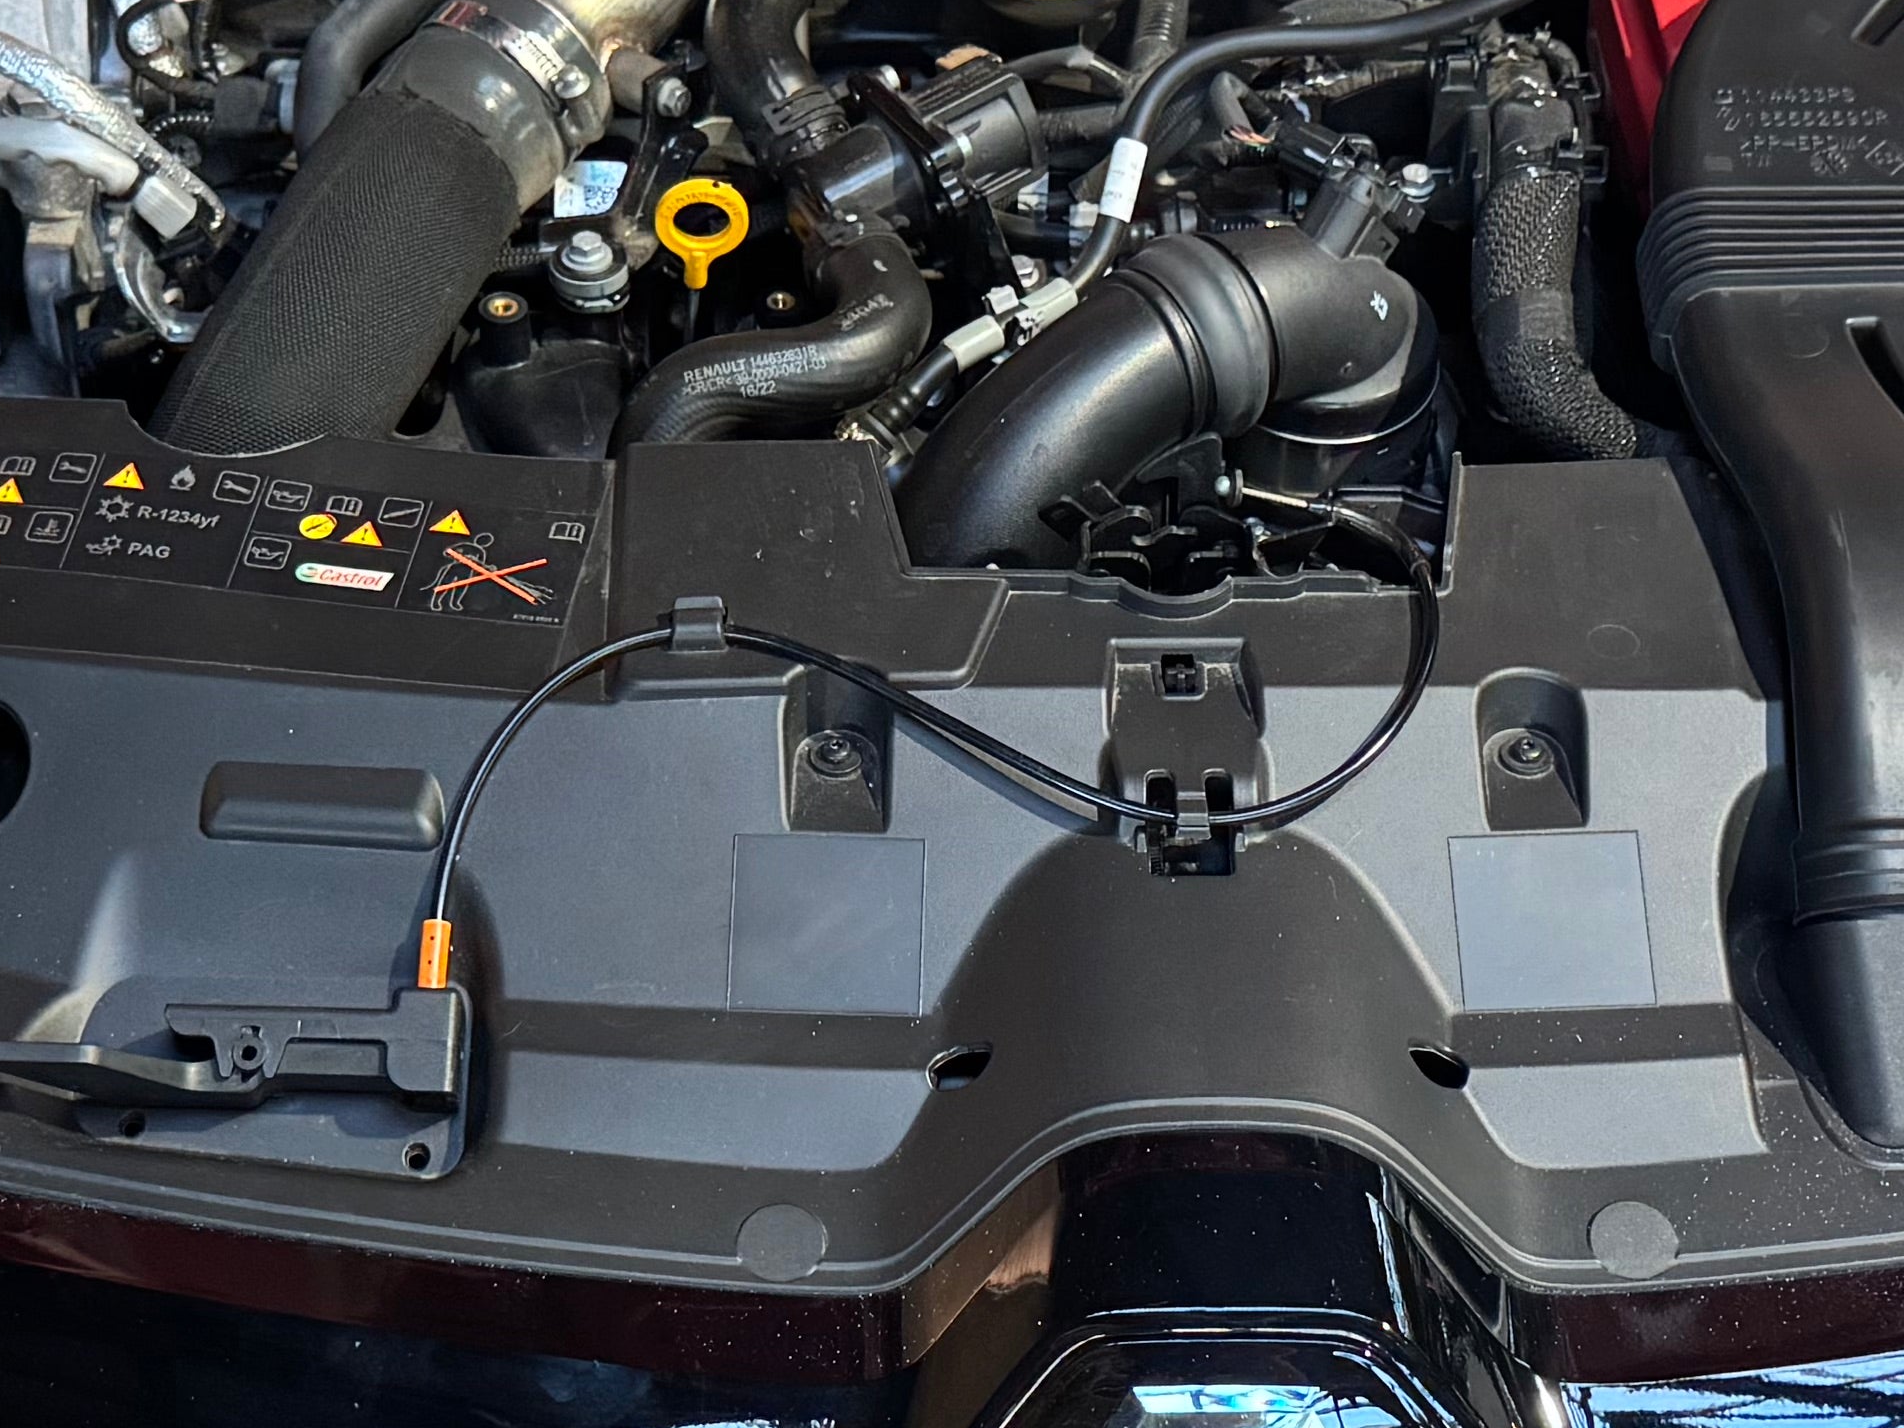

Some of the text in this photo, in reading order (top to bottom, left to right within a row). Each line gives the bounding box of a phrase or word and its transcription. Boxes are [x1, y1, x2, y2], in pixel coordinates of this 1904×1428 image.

[683, 360, 747, 382] RENAULT
[137, 505, 221, 529] R-1234yf
[127, 542, 171, 559] PAG
[319, 568, 384, 587] Castrol
